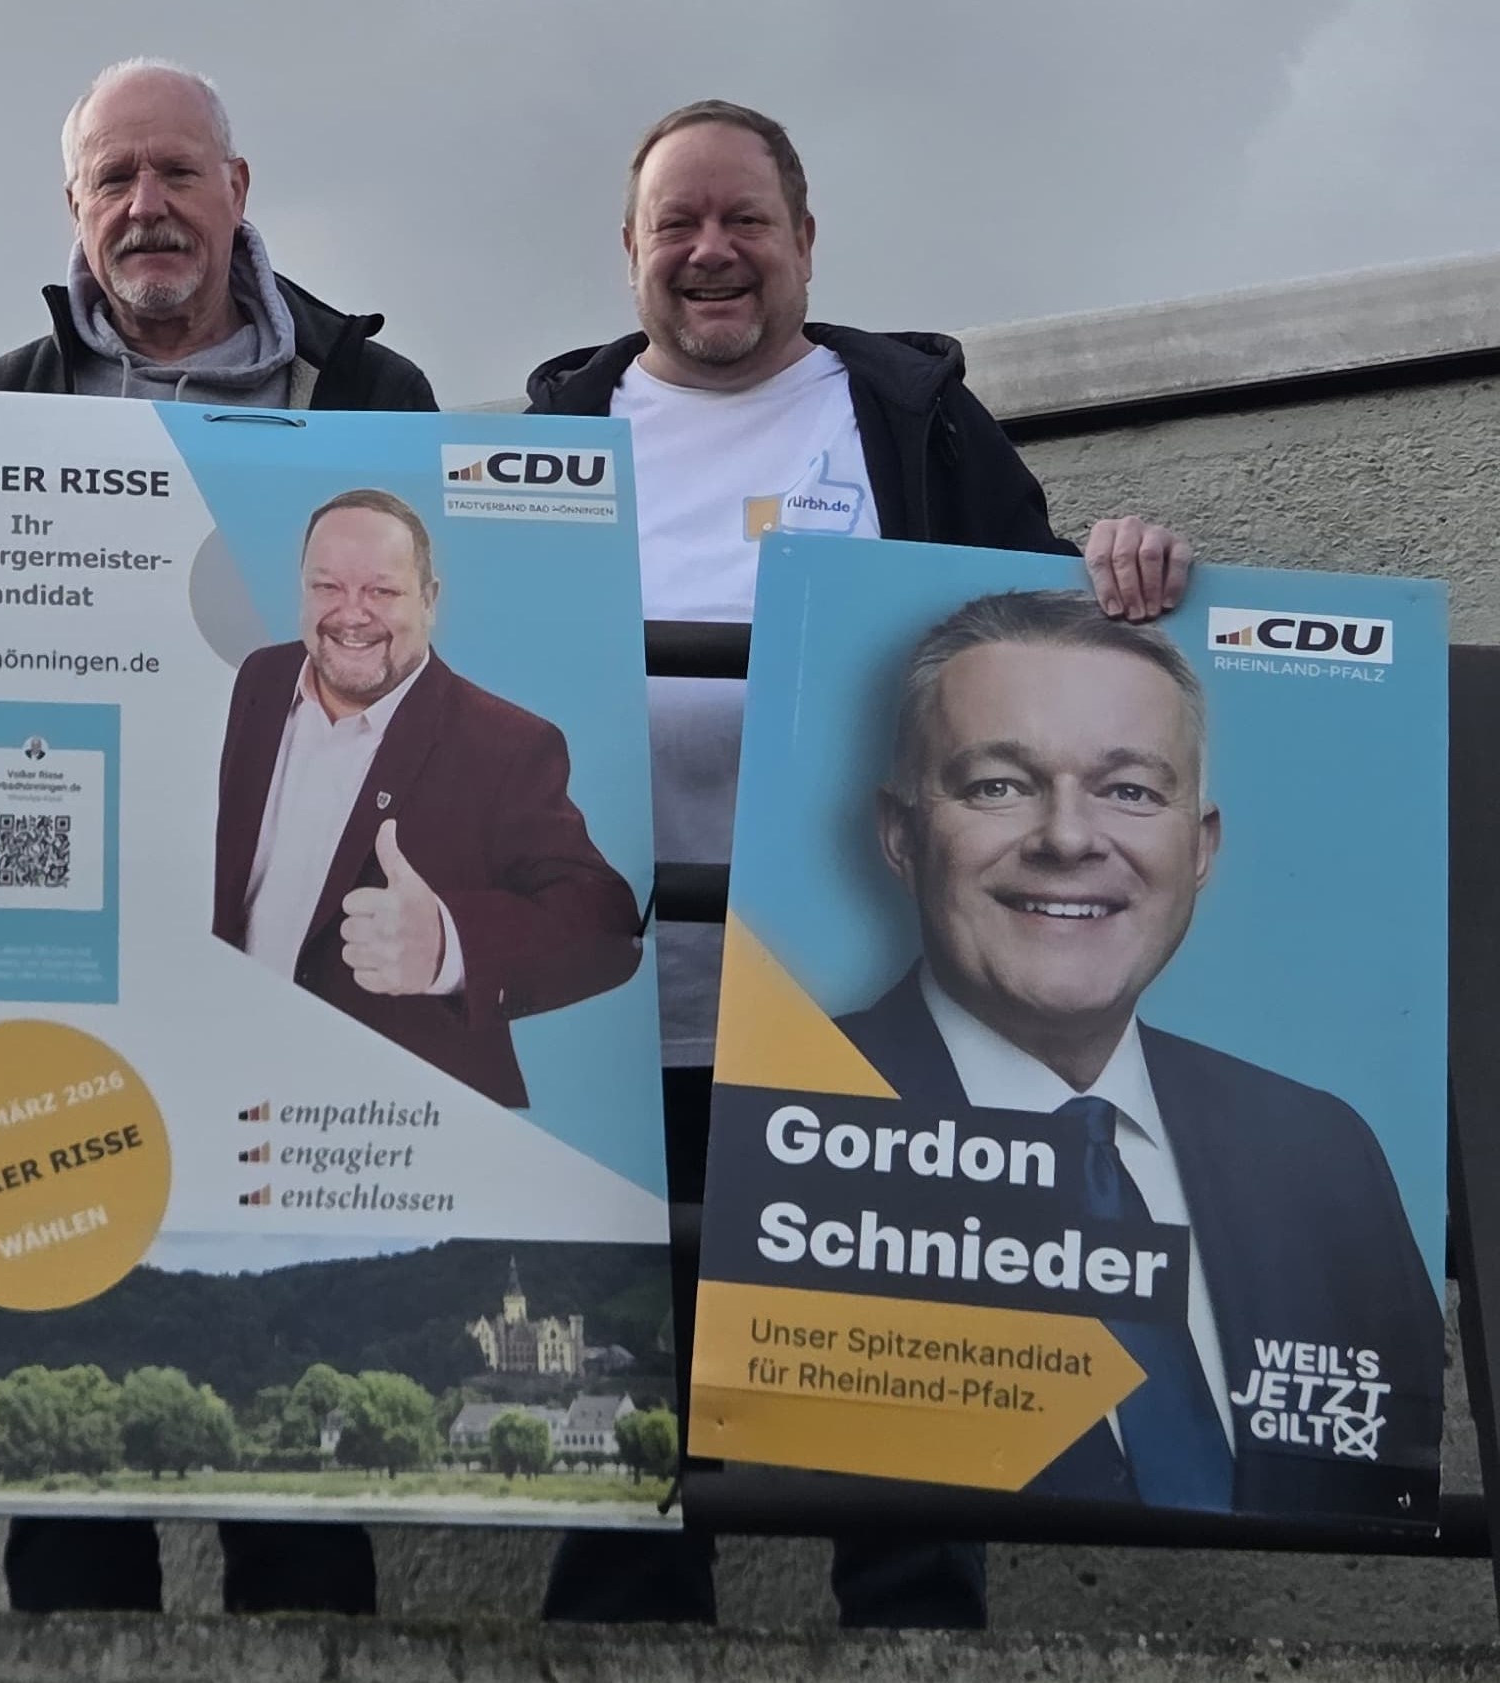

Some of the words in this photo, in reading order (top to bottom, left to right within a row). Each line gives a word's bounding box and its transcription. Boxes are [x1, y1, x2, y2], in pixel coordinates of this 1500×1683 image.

[61, 467, 170, 497] RISSE
[487, 452, 606, 486] CDU
[10, 514, 53, 536] Ihr
[529, 504, 550, 514] BAD
[1257, 618, 1384, 655] CDU
[1214, 656, 1385, 683] RHEINLAND-PFALZ
[64, 1070, 125, 1106] 2026
[280, 1100, 440, 1132] empathisch
[49, 1124, 143, 1173] RISSE
[280, 1142, 414, 1174] engagiert
[765, 1105, 1056, 1188] Gordon
[280, 1183, 454, 1212] entschlossen
[757, 1201, 1168, 1298] Schnieder
[751, 1318, 838, 1351] Unser
[848, 1327, 1093, 1377] Spitzenkandidat
[747, 1359, 789, 1385] für
[799, 1366, 1044, 1413] Rheinland-Pfalz.
[1230, 1370, 1391, 1418] JETZT
[1250, 1410, 1331, 1446] GILT
